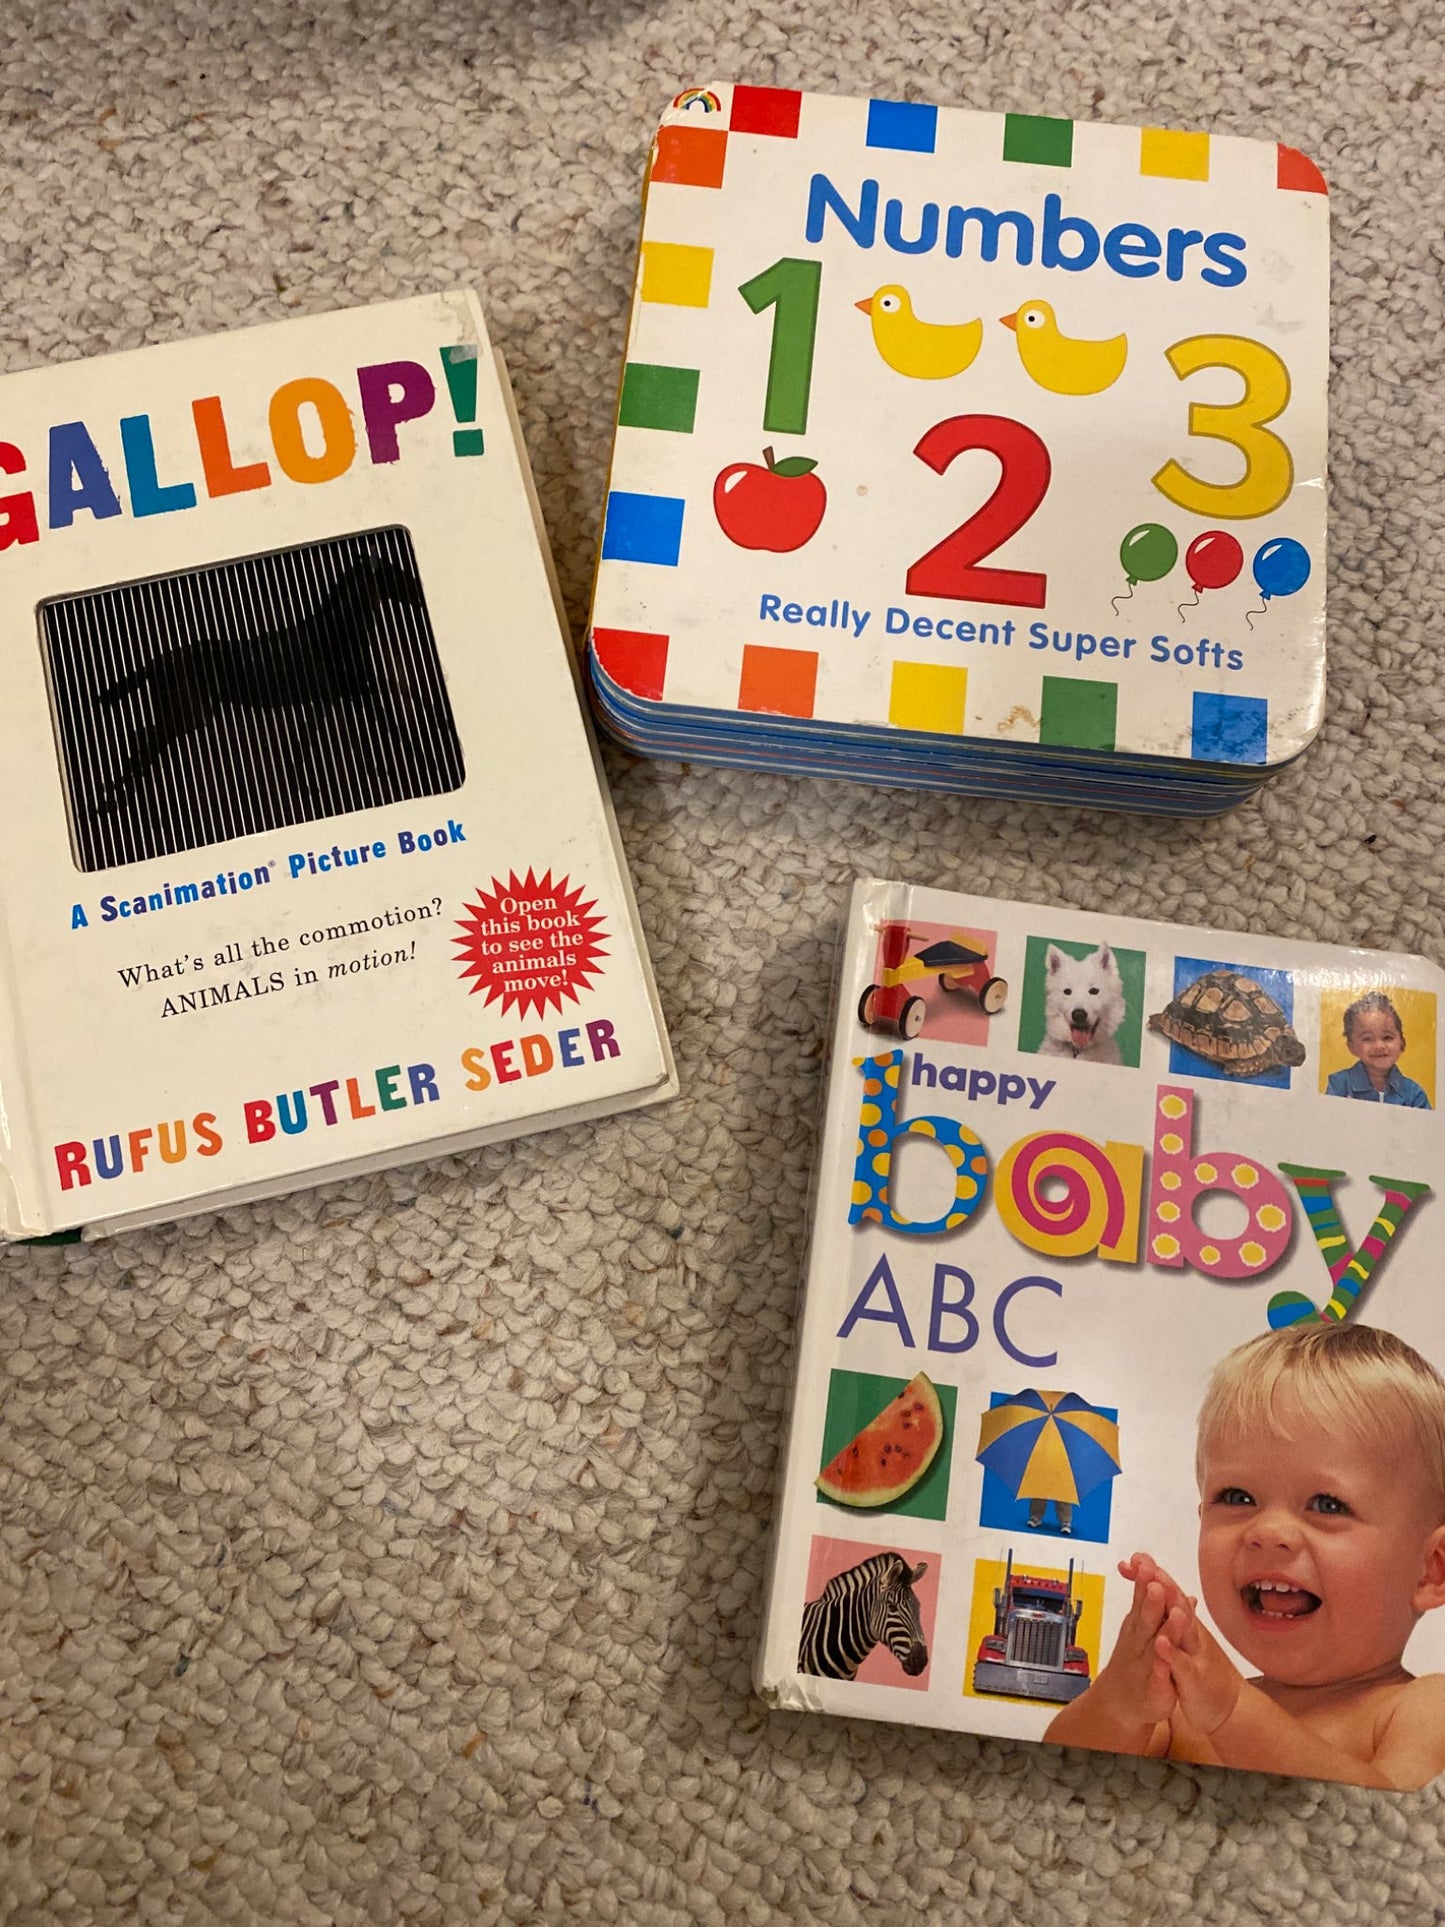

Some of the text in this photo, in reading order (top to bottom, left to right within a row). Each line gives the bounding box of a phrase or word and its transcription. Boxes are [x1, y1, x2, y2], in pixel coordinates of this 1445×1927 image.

[805, 173, 1247, 287] Numbers
[738, 257, 1295, 610] 1 2 3
[759, 593, 1244, 672] Really Decent Super Softs
[71, 904, 88, 929] A
[288, 837, 387, 880] Picture
[398, 820, 466, 855] Book
[500, 897, 557, 916] Open
[213, 944, 244, 967] all
[251, 935, 290, 958] the
[299, 897, 444, 948] commotion?
[480, 909, 580, 935] this book
[480, 930, 584, 955] to see the
[160, 942, 417, 1019] ANIMALS in motion!
[491, 950, 577, 974] animals
[503, 970, 568, 992] move!
[54, 1018, 622, 1191] RUFUS BUTLER SEDER
[911, 1052, 1057, 1109] happy
[848, 1048, 1431, 1330] baby
[835, 1252, 1063, 1368] ABC
